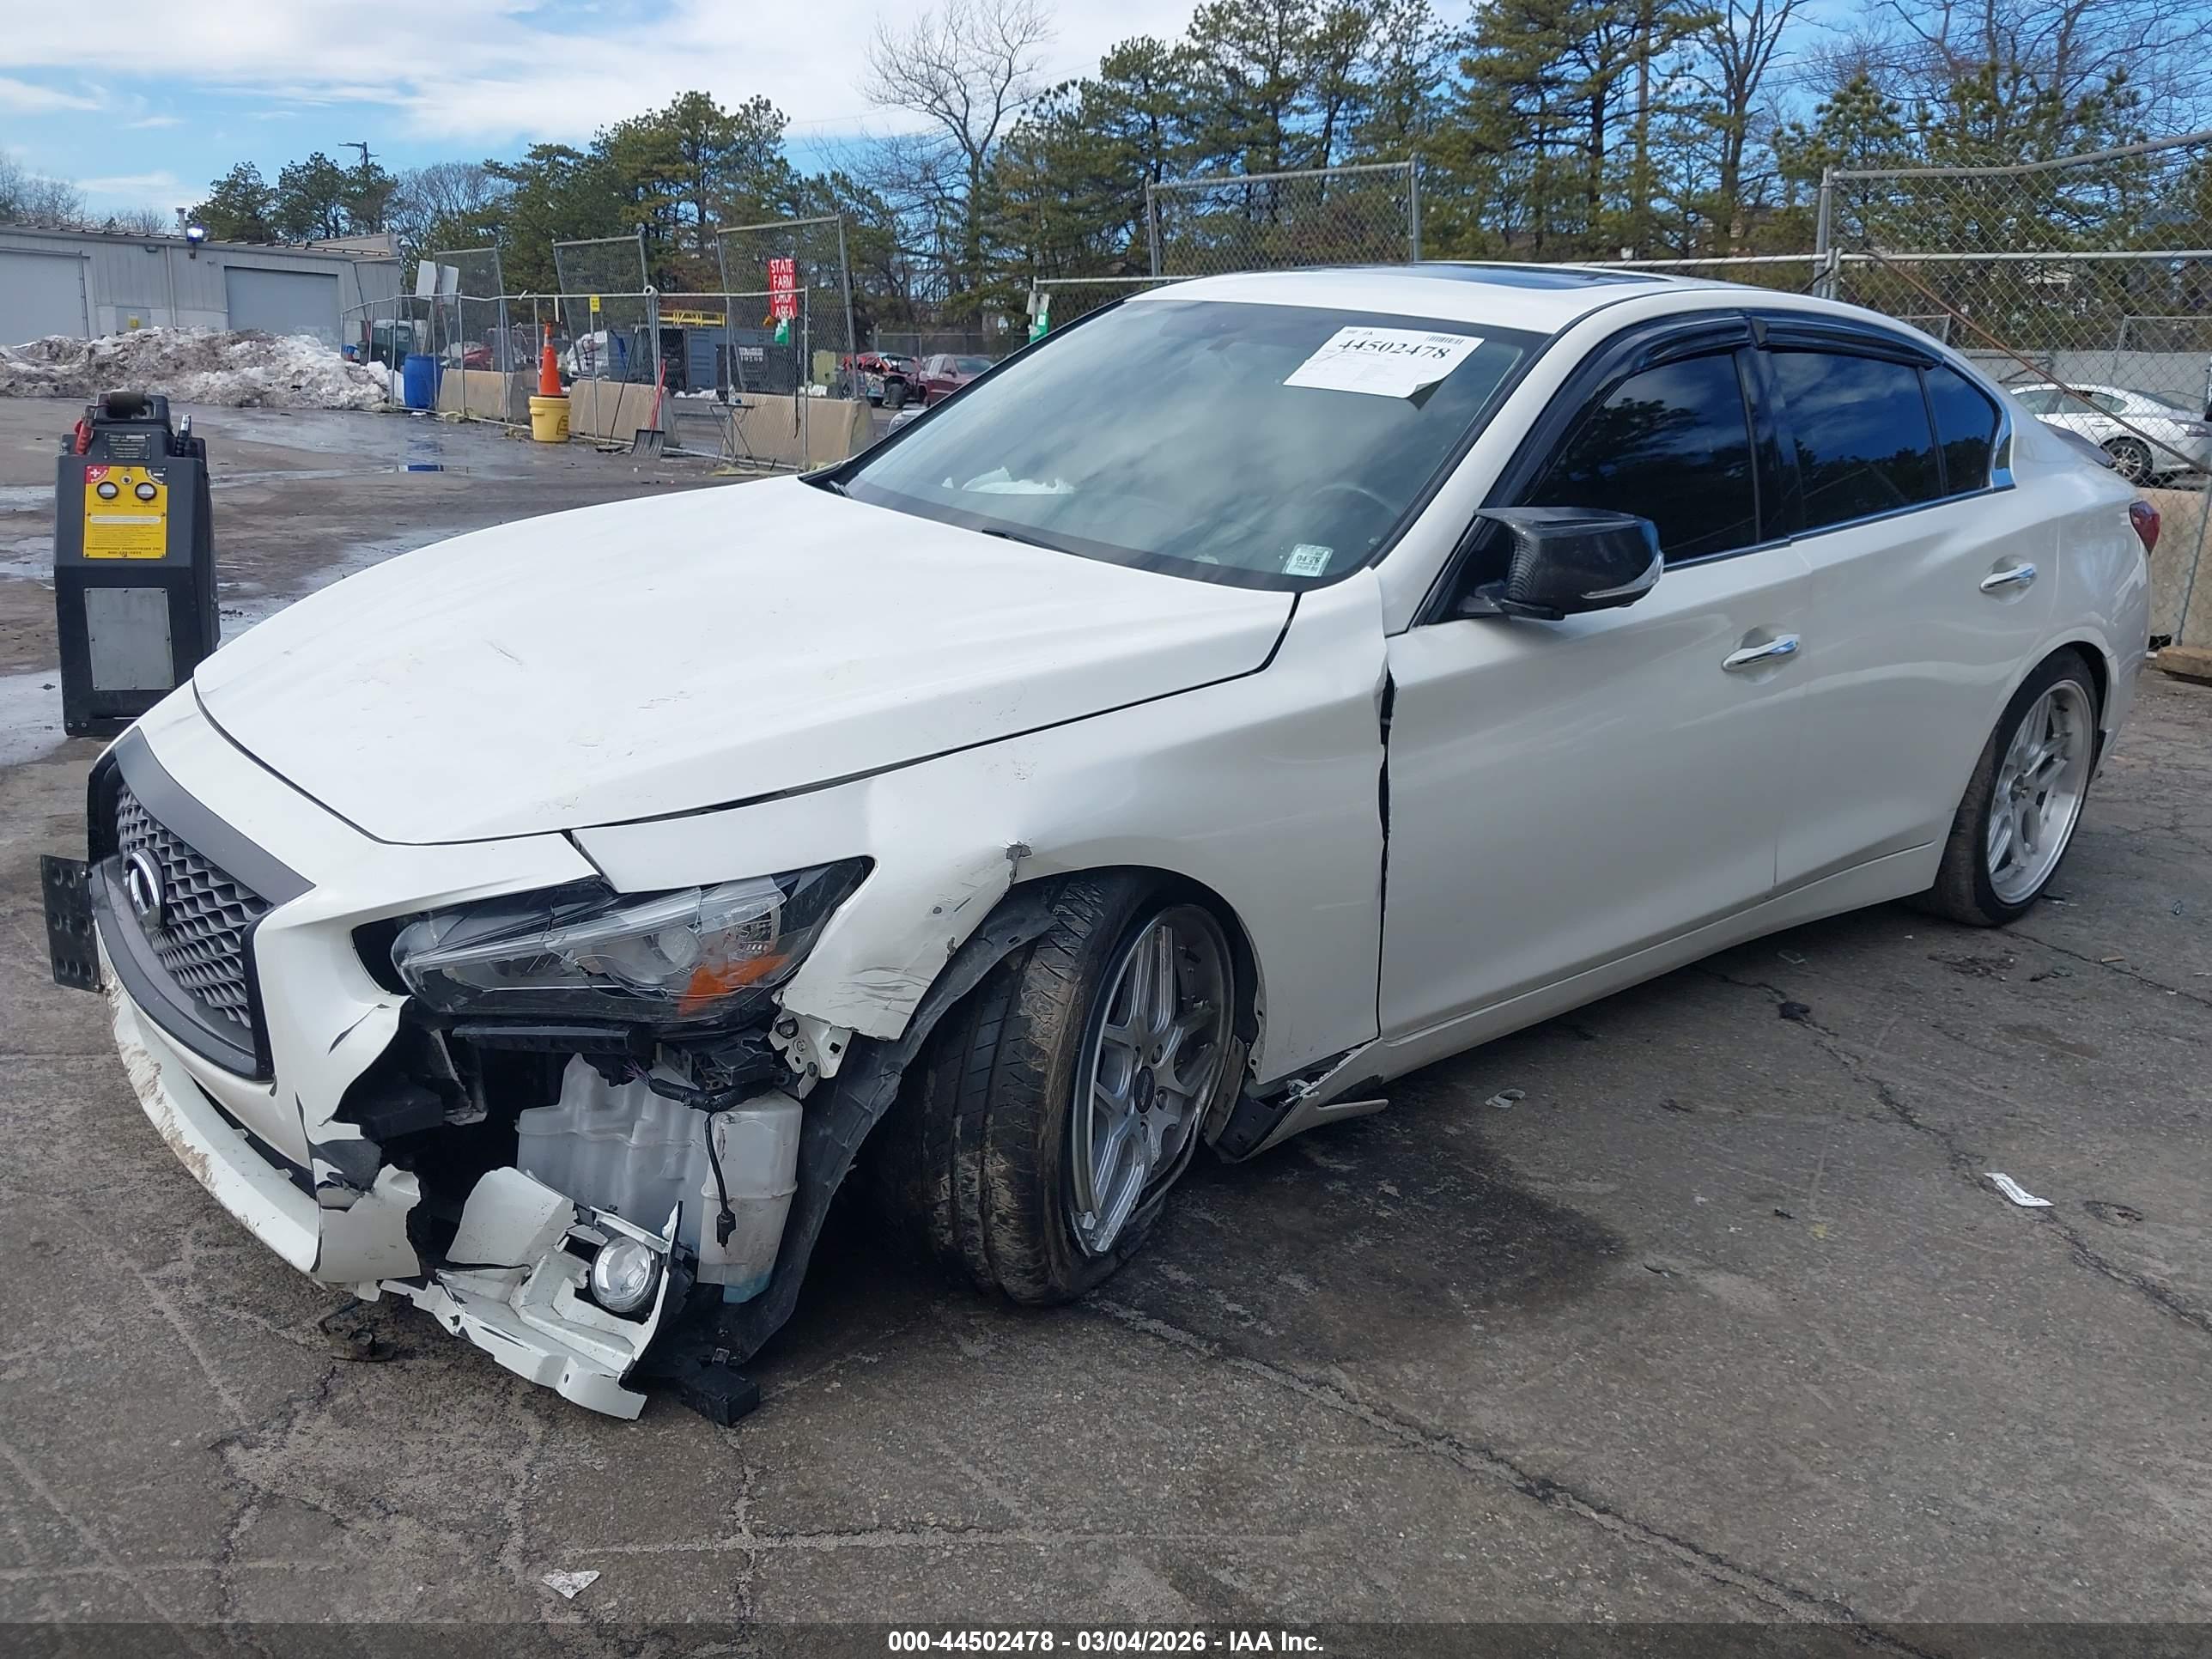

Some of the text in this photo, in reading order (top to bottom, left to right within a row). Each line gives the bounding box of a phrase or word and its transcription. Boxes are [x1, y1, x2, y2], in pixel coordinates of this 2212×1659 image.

[770, 258, 793, 273] STATE
[773, 275, 793, 289] FARM
[774, 289, 793, 304] DROP
[775, 305, 795, 320] AREA
[1338, 339, 1451, 359] 44502478
